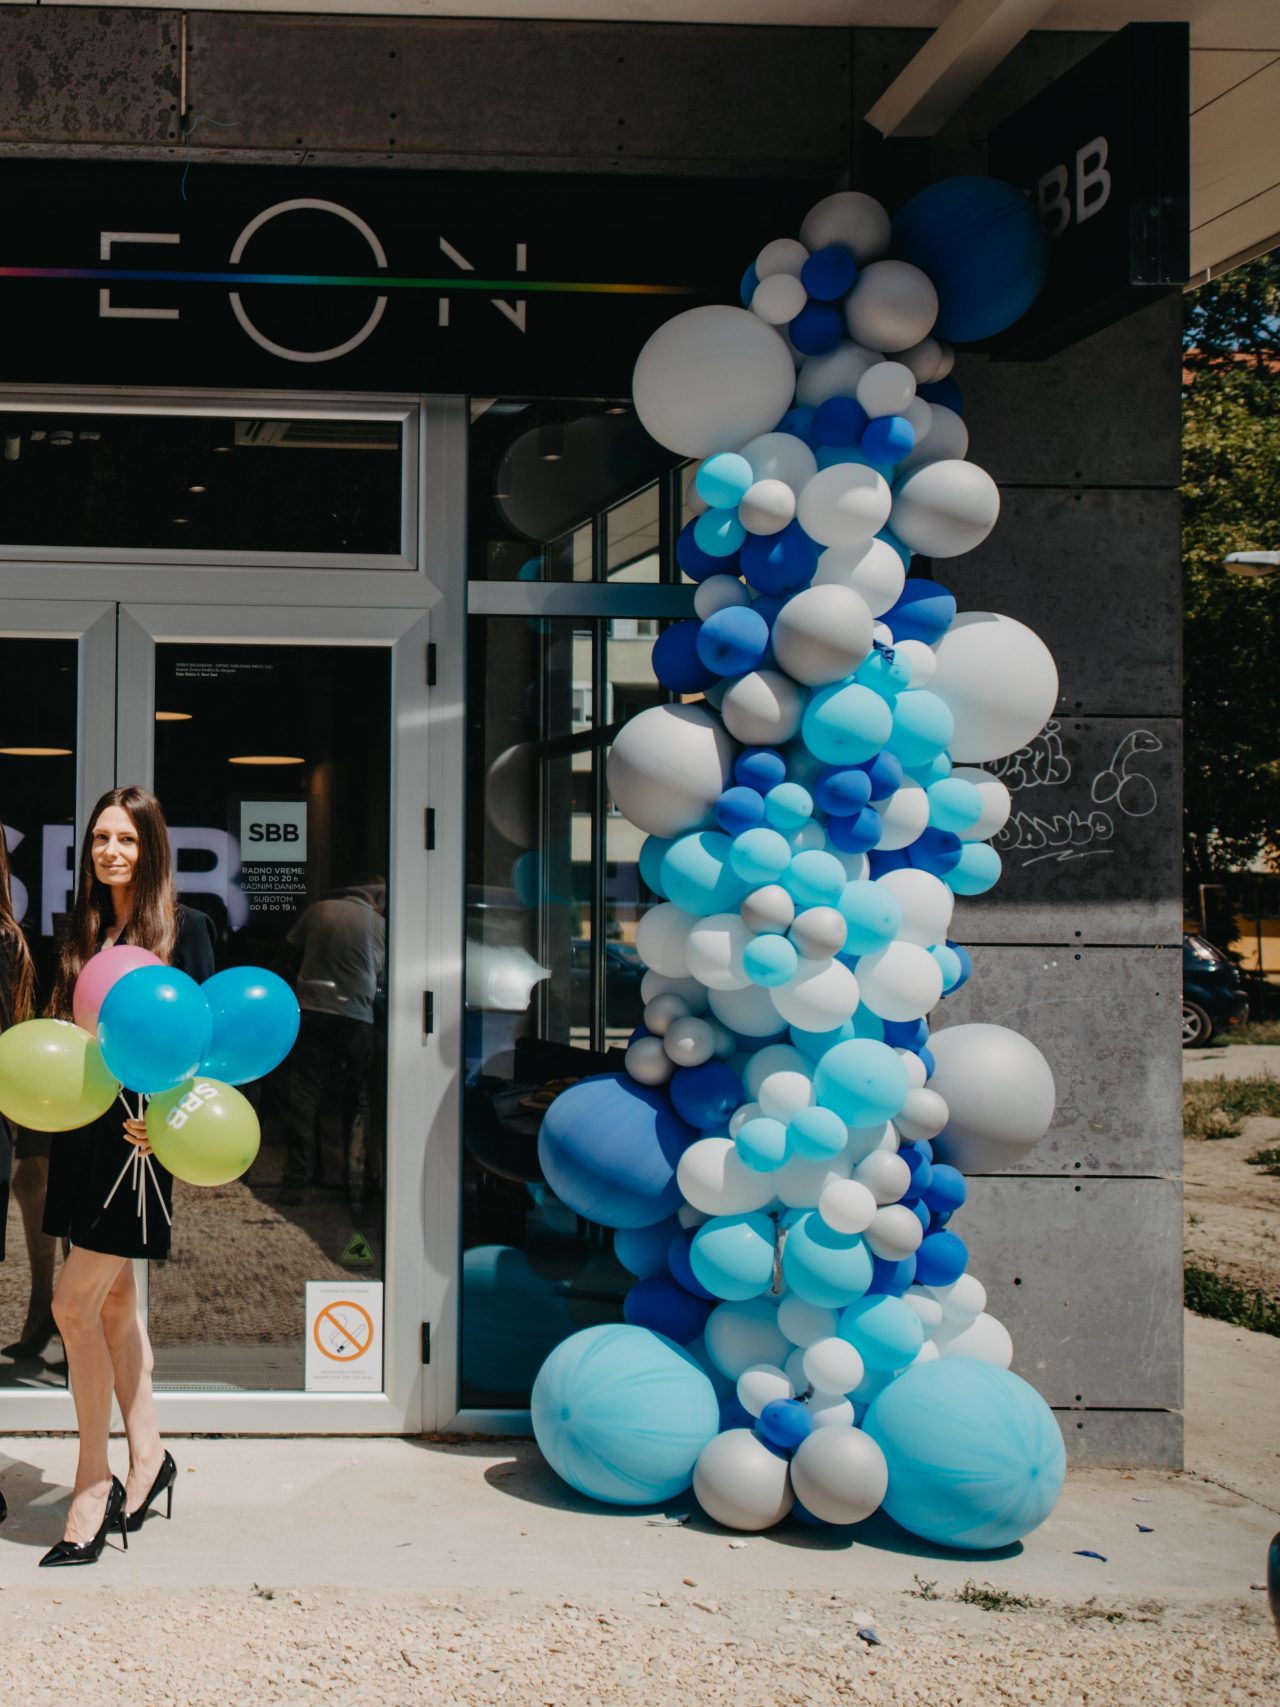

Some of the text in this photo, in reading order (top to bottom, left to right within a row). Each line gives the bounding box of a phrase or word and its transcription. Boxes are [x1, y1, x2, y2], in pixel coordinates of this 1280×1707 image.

[1023, 135, 1111, 238] BB
[99, 198, 528, 363] EON
[248, 823, 300, 842] SBB
[242, 867, 305, 875] RADNO VREME:
[253, 895, 294, 903] SUBOTOM
[166, 1083, 218, 1130] SBB
